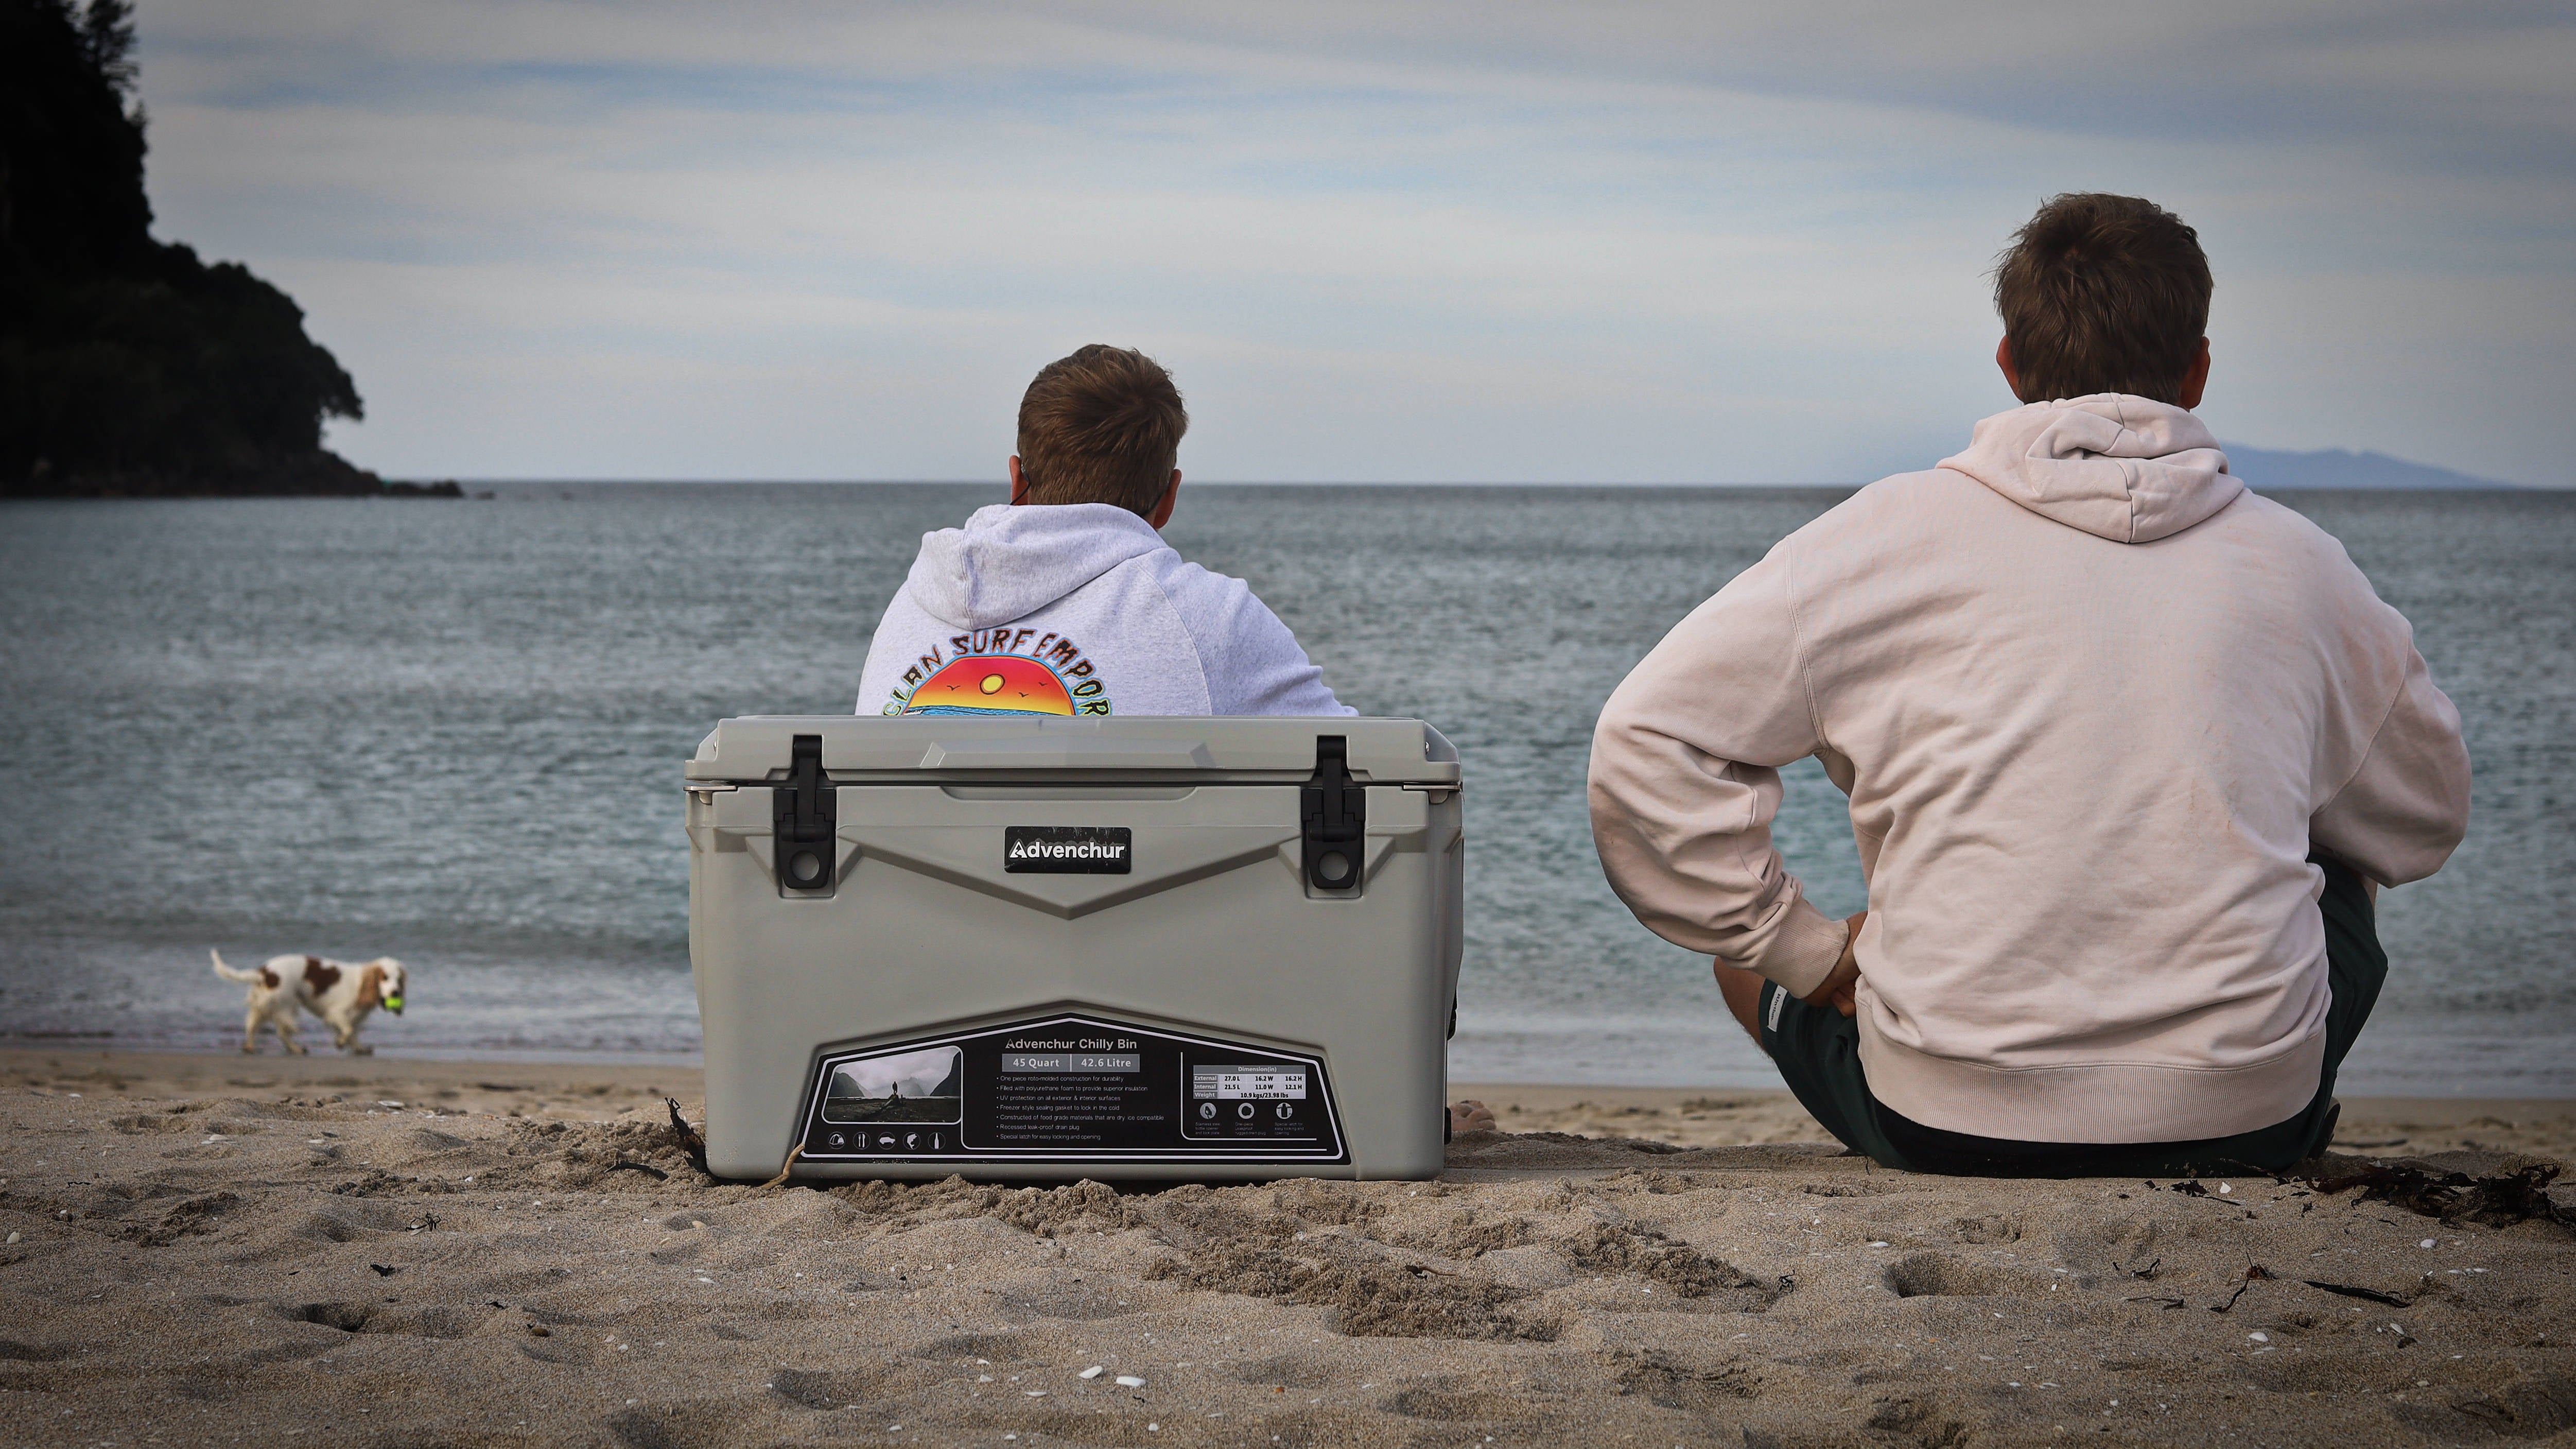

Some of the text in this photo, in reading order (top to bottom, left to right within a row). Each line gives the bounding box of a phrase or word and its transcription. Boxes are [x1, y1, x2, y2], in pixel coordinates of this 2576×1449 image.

[951, 628, 1036, 656] SURF
[1034, 633, 1111, 715] EMPOR
[1009, 841, 1125, 858] Advenchur
[1005, 1039, 1137, 1050] Advenchur Chilly Bin
[1013, 1058, 1059, 1068] 45 Quart
[1081, 1058, 1132, 1067] 42.6 Litre
